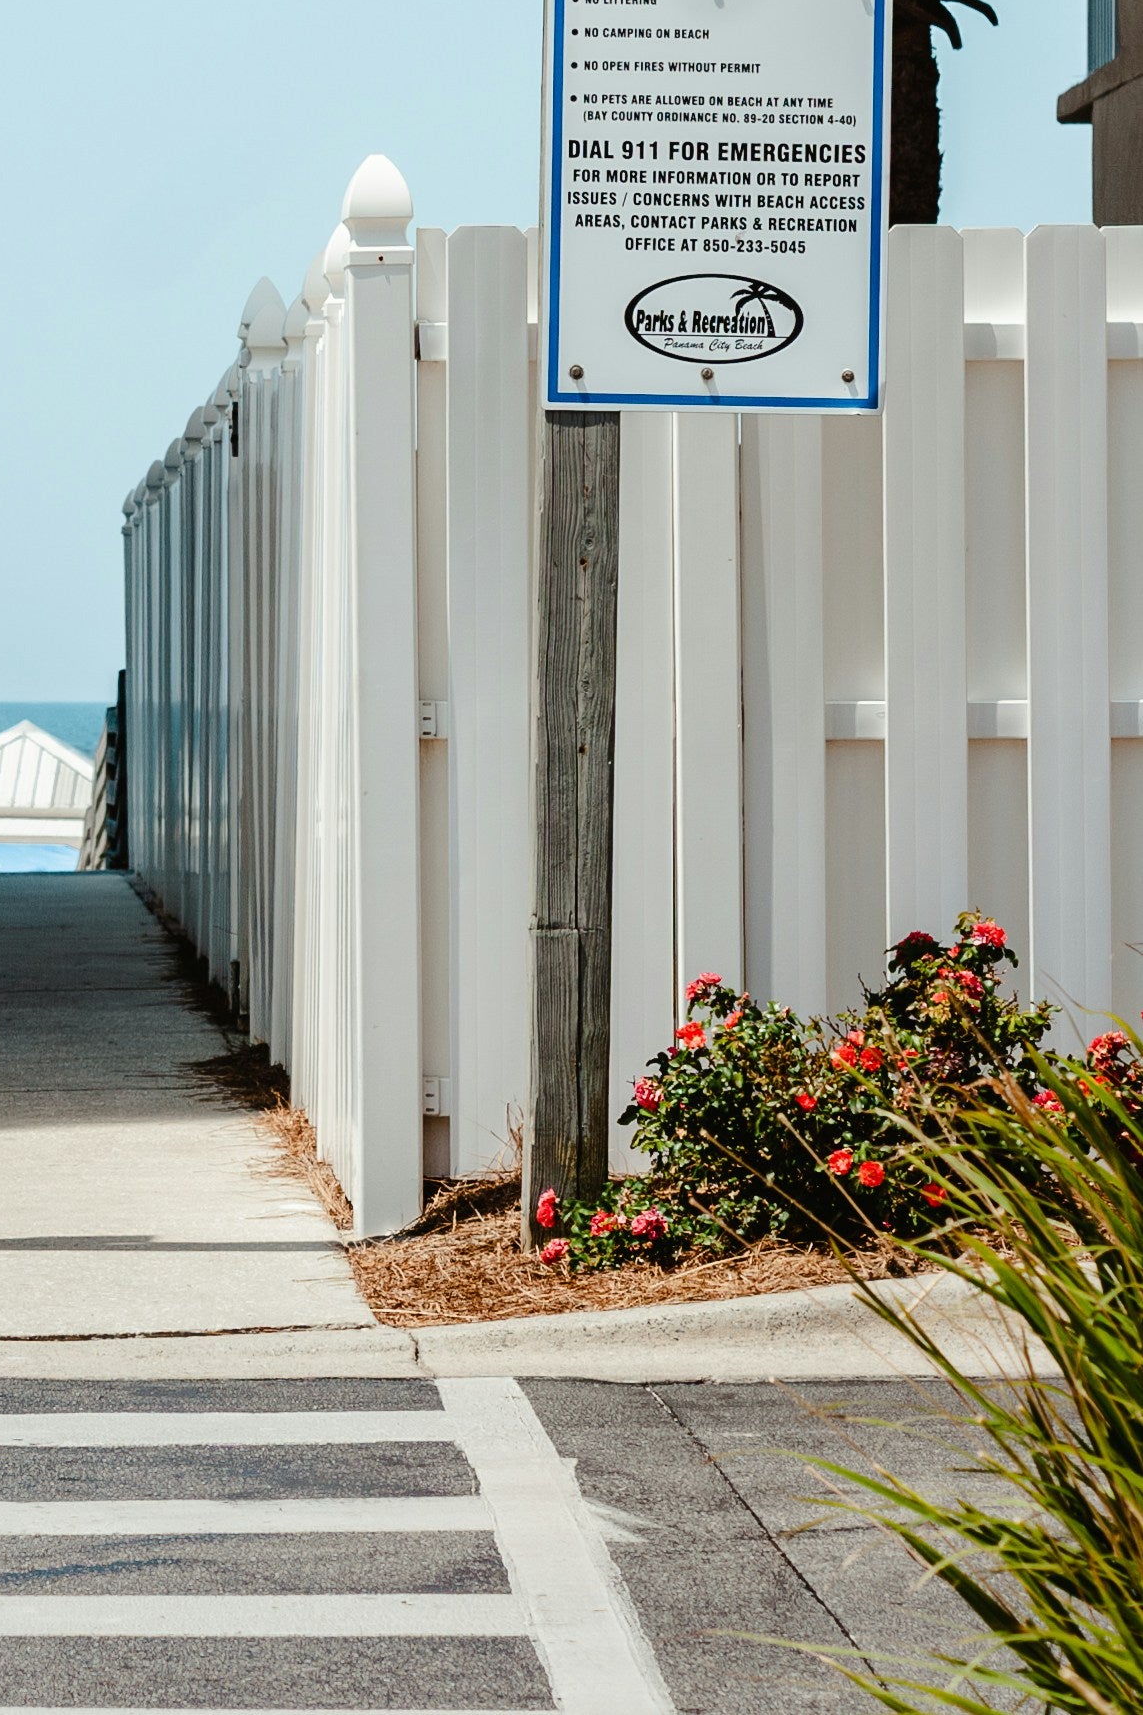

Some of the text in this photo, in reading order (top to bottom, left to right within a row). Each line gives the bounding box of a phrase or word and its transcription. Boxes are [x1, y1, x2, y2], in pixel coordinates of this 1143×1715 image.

[584, 27, 709, 39] NO CAMPING ON BEACH
[584, 60, 760, 73] NO OPEN FIRES WITHOUT PERMIT
[583, 93, 833, 108] NO PETS ARE ALLOWED ON BEACH AT ANY TIME
[583, 110, 856, 127] (BAY COUNTY ORDINANCE NO. 89-20 SECTION 4-40)
[568, 140, 865, 162] DIAL 911 FOR EMERGENCIES
[573, 168, 860, 187] FOR MORE INFORMATION OR TO REPORT
[567, 191, 616, 205] ISSUES
[632, 192, 709, 206] CONCERNS
[714, 194, 751, 207] WITH
[757, 194, 804, 208] BEACH
[809, 195, 864, 210] ACCESS
[575, 214, 857, 232] AREAS, CONTACT PARKS & RECREATION
[625, 237, 805, 253] OFFICE AT 850-233-5045
[636, 309, 766, 334] Parks & Recreation
[664, 338, 763, 352] Panama City Beach
